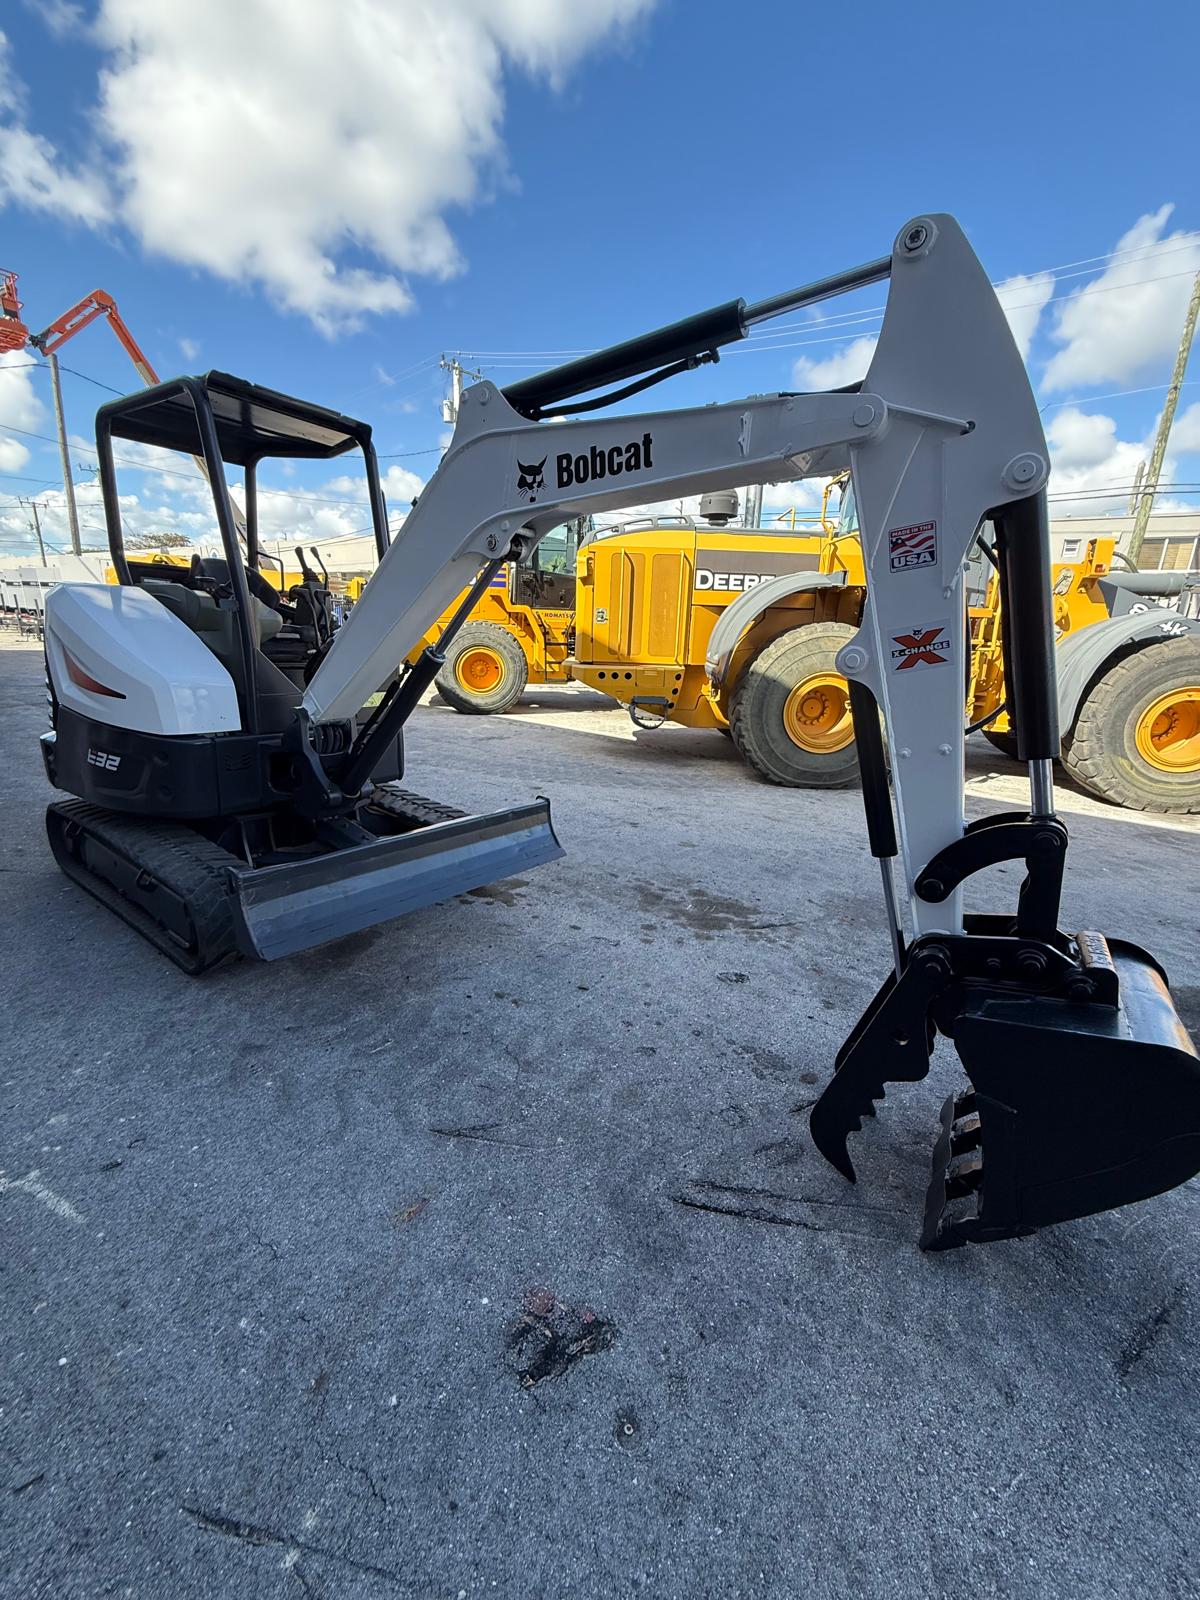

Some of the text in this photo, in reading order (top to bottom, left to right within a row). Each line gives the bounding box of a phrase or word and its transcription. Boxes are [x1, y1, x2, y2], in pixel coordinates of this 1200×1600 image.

[556, 433, 653, 489] Bobcat
[892, 529, 910, 537] MADE
[893, 552, 932, 567] USA
[893, 640, 950, 657] X-CHANGE
[87, 748, 121, 771] E32
